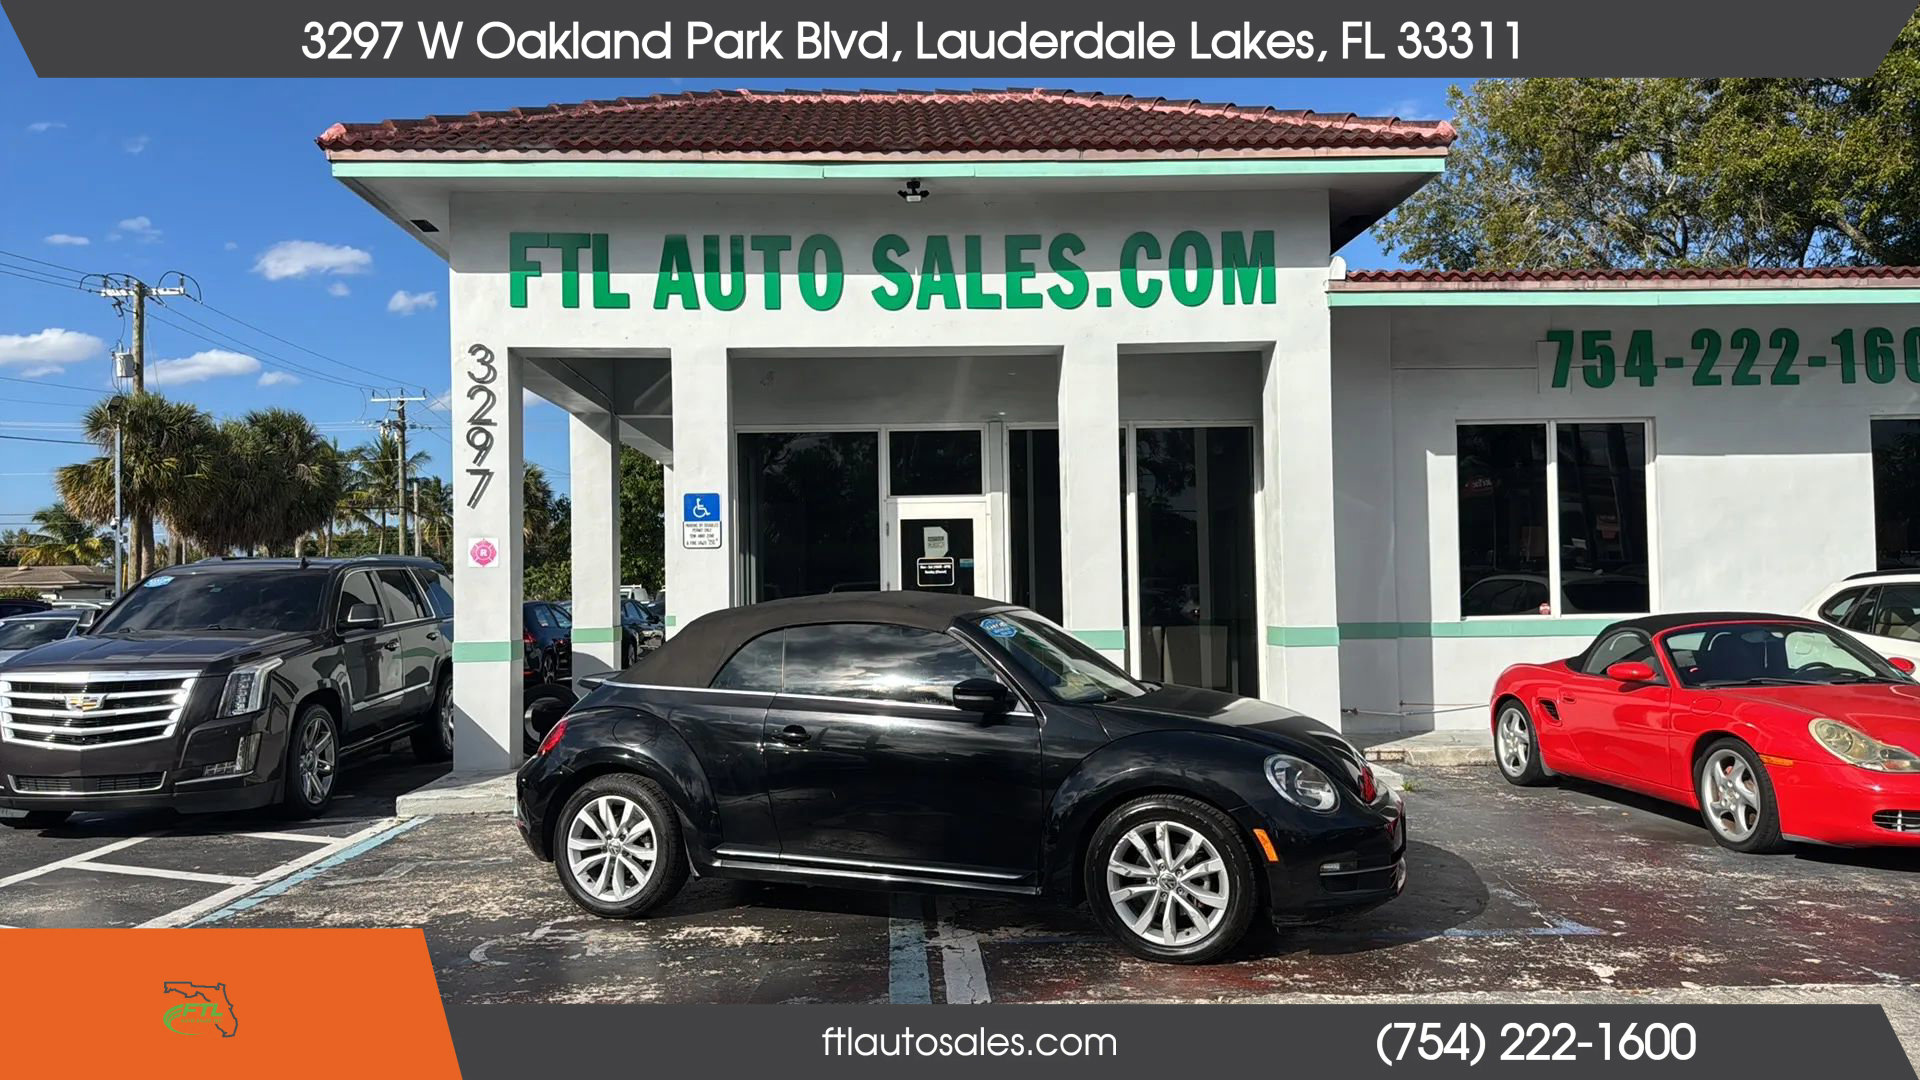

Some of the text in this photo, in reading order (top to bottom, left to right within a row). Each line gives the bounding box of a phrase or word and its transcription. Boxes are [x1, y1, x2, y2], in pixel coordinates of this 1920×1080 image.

[509, 231, 1277, 312] FTL AUTO SALES.COM
[466, 343, 498, 510] 3297
